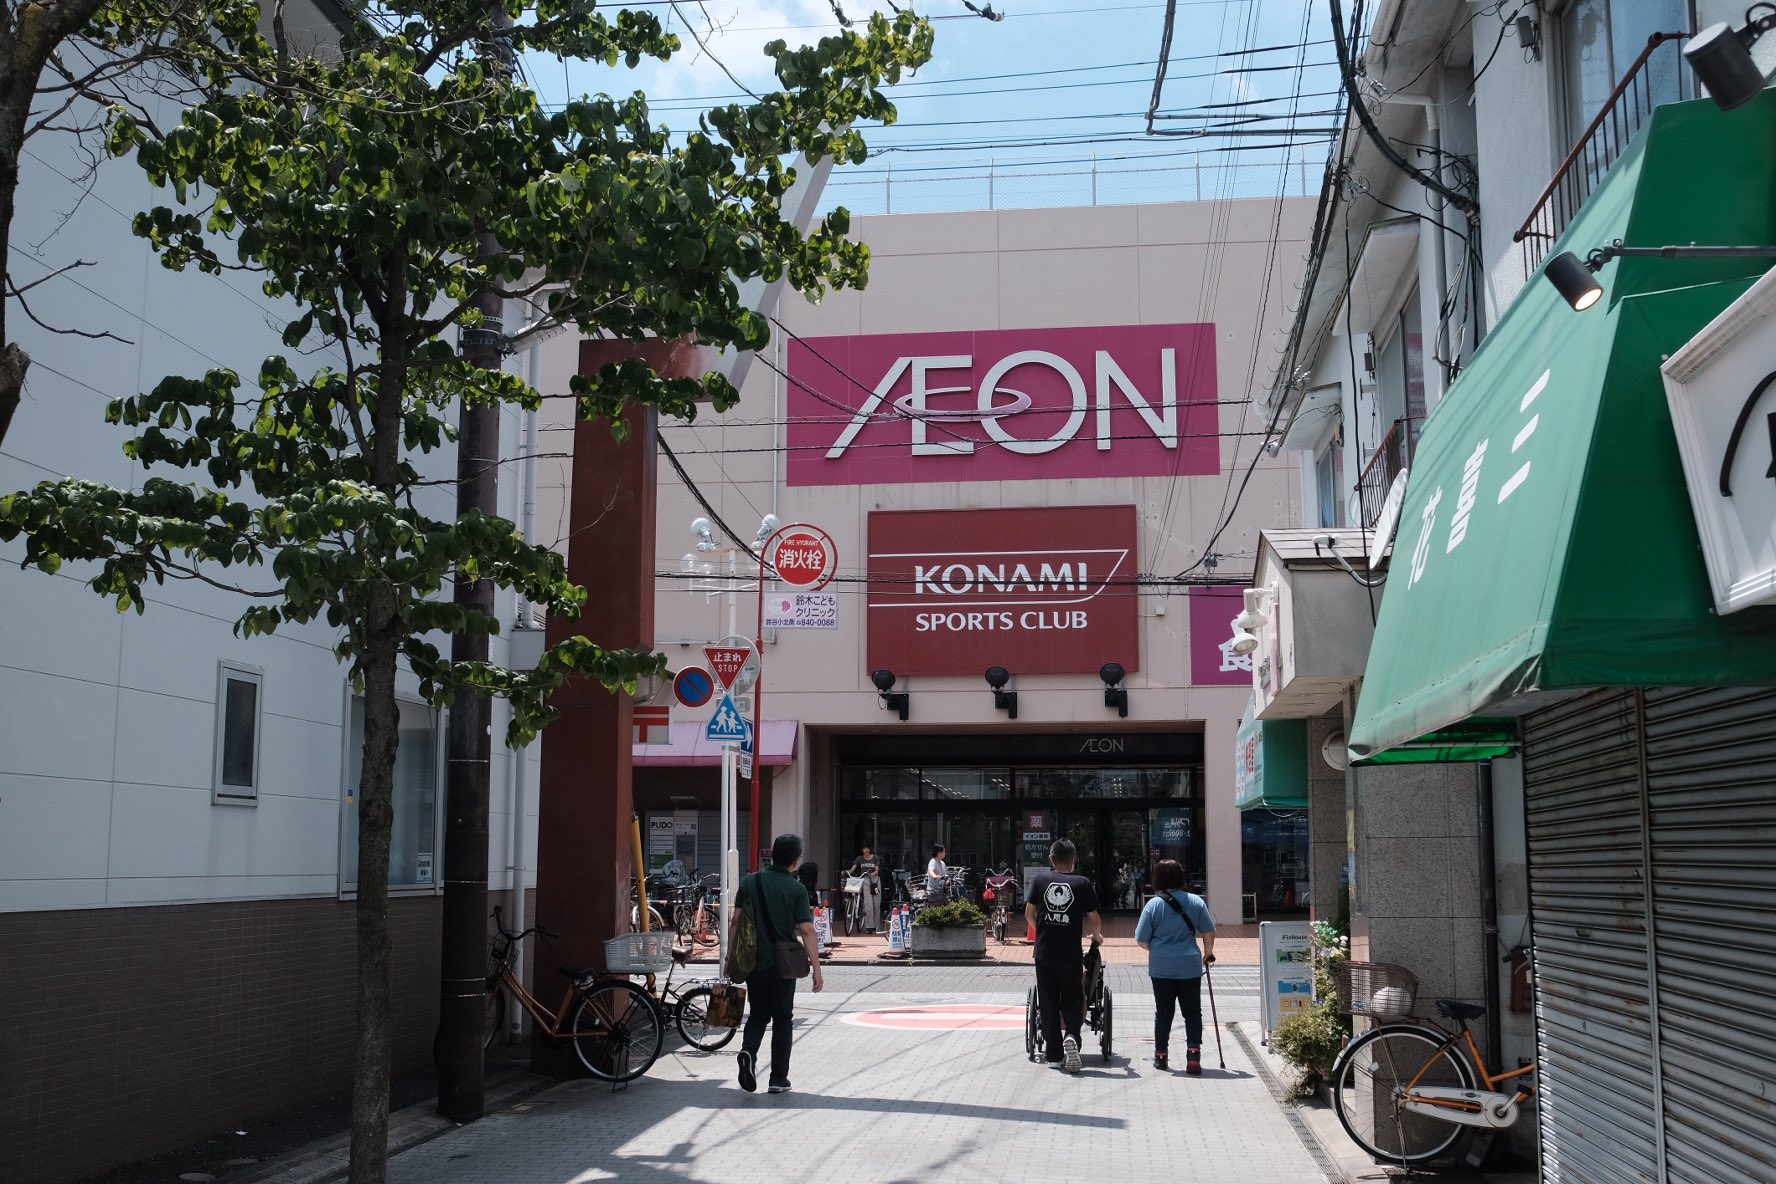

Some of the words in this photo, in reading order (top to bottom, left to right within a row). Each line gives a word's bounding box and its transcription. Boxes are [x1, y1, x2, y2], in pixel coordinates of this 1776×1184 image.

[779, 549, 823, 569] 消火栓
[914, 562, 1088, 594] KONAMI
[796, 595, 835, 606] 鈴木こども
[796, 607, 835, 617] クリニック
[915, 612, 1013, 632] SPORTS
[1020, 610, 1088, 630] CLUB
[713, 652, 742, 662] 止まれ
[718, 664, 738, 672] STOP
[1030, 815, 1043, 828] 薬
